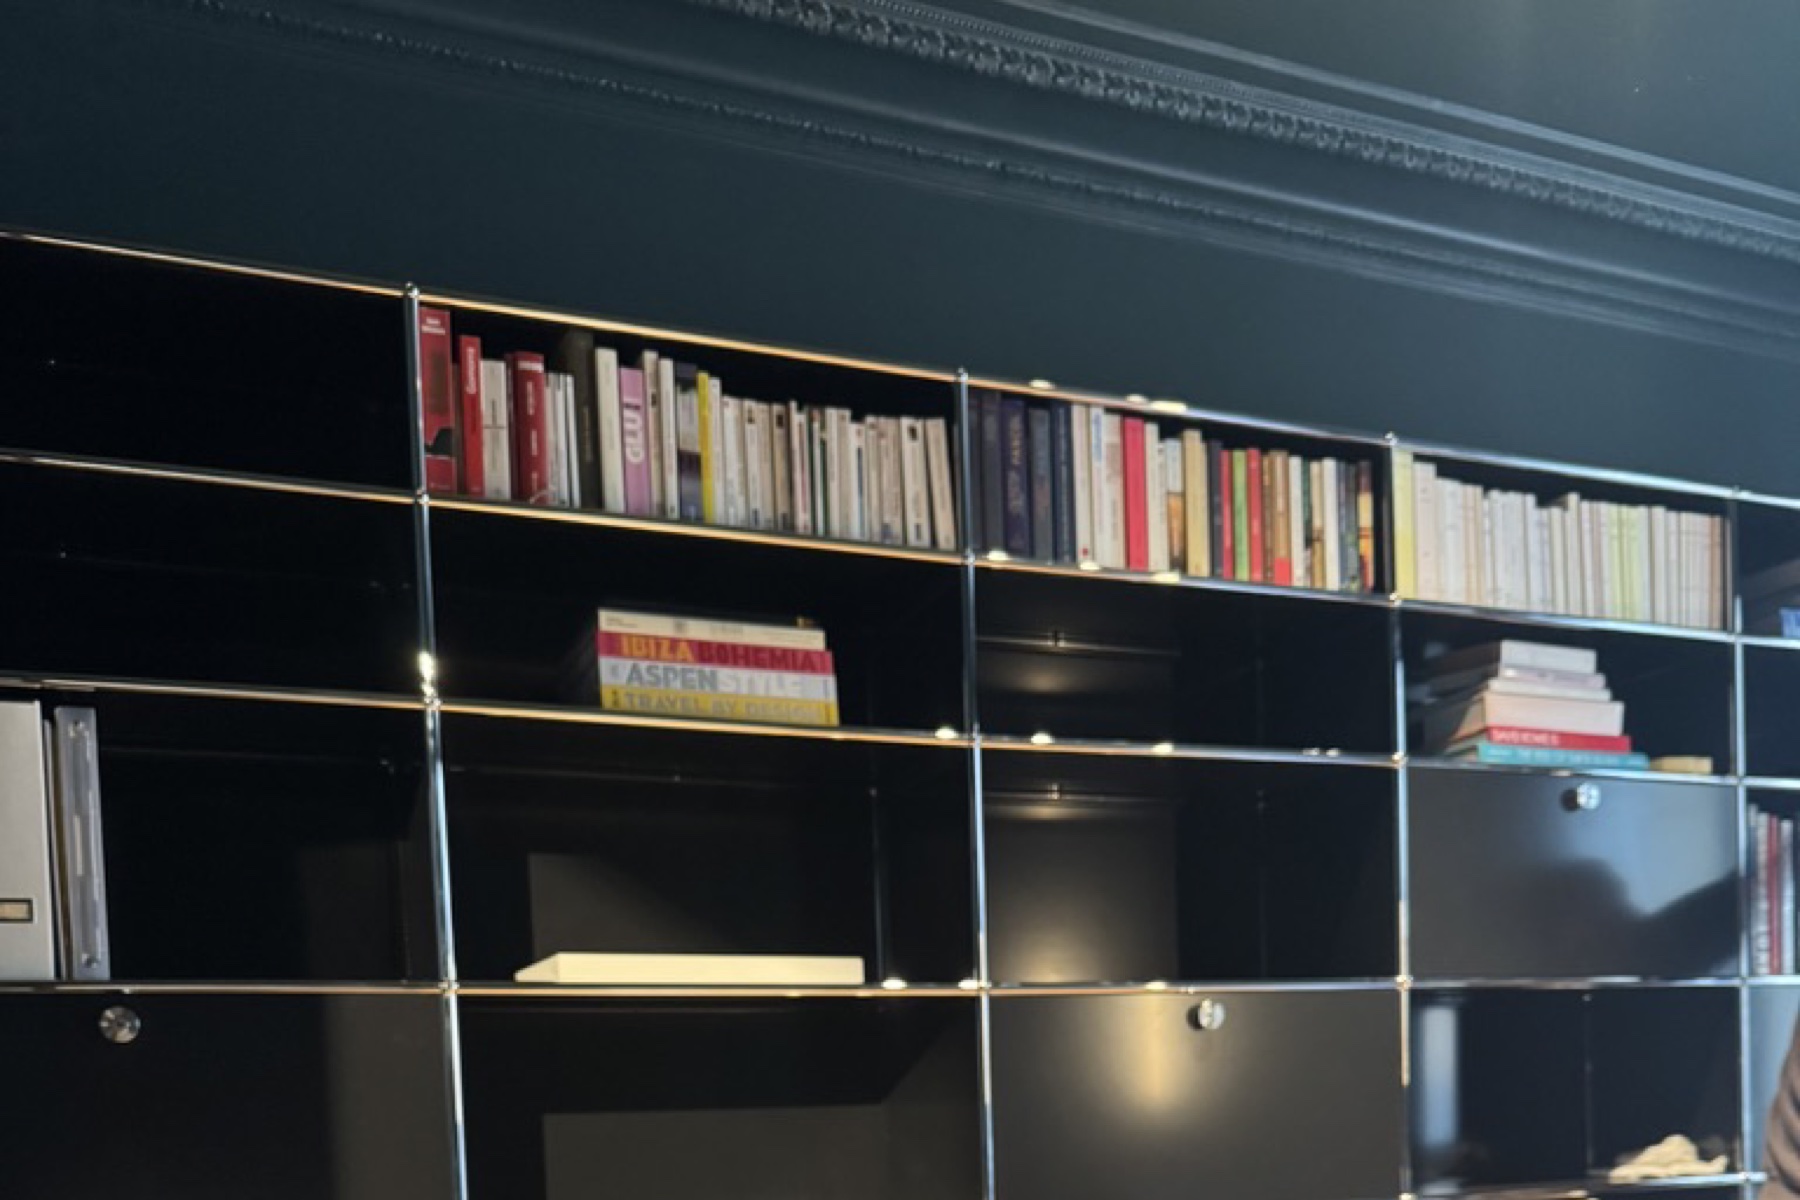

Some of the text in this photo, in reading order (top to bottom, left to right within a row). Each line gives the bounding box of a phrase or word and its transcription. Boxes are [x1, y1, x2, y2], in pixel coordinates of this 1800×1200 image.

[621, 633, 817, 672] IBIZA BOHEMIA
[625, 662, 718, 691] ASPEN
